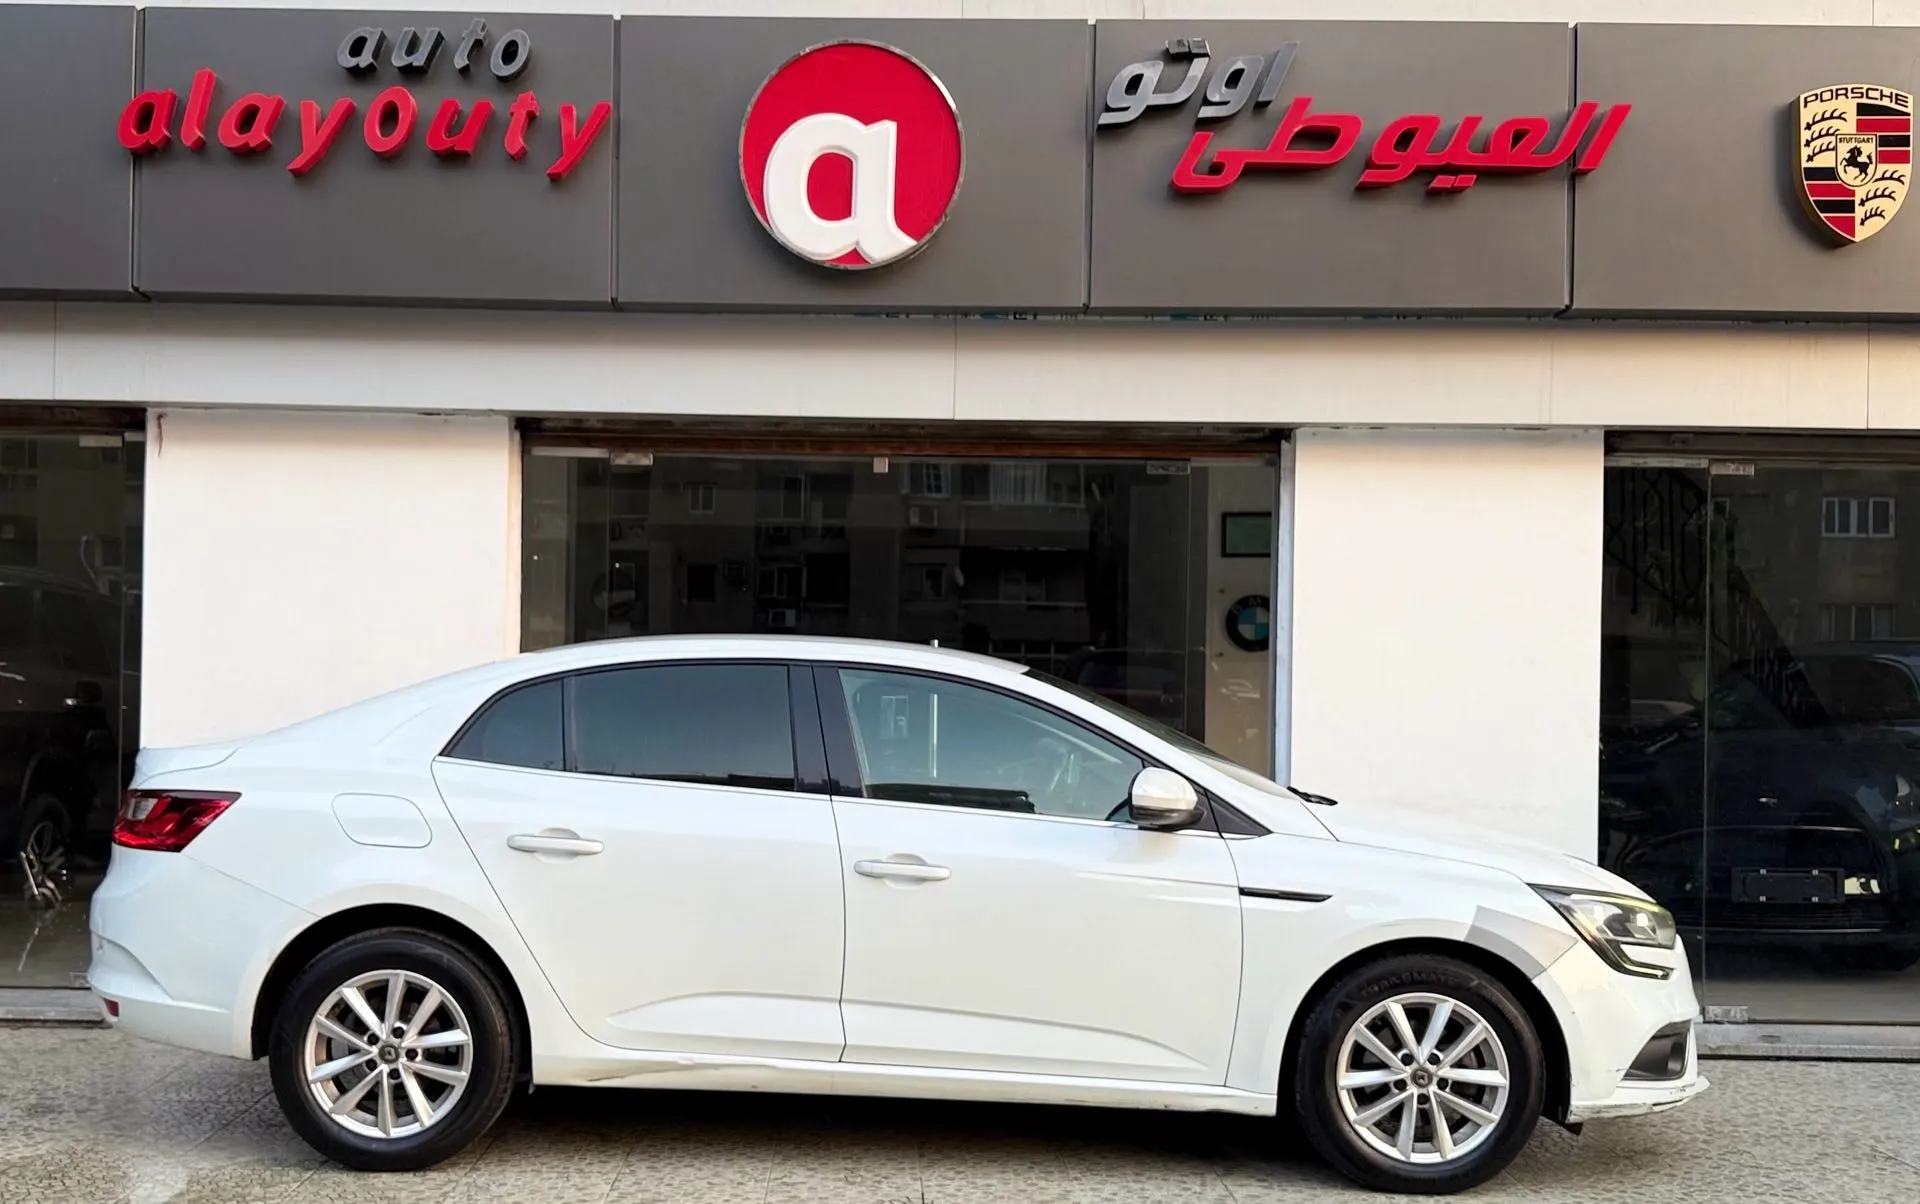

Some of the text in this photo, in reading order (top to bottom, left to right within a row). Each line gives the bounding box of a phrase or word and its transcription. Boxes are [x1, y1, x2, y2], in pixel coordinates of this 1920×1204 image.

[337, 17, 532, 81] auto
[1097, 38, 1299, 126] اوتو
[117, 68, 612, 181] alayouty
[1804, 87, 1909, 108] PORSCHE
[763, 112, 919, 265] a
